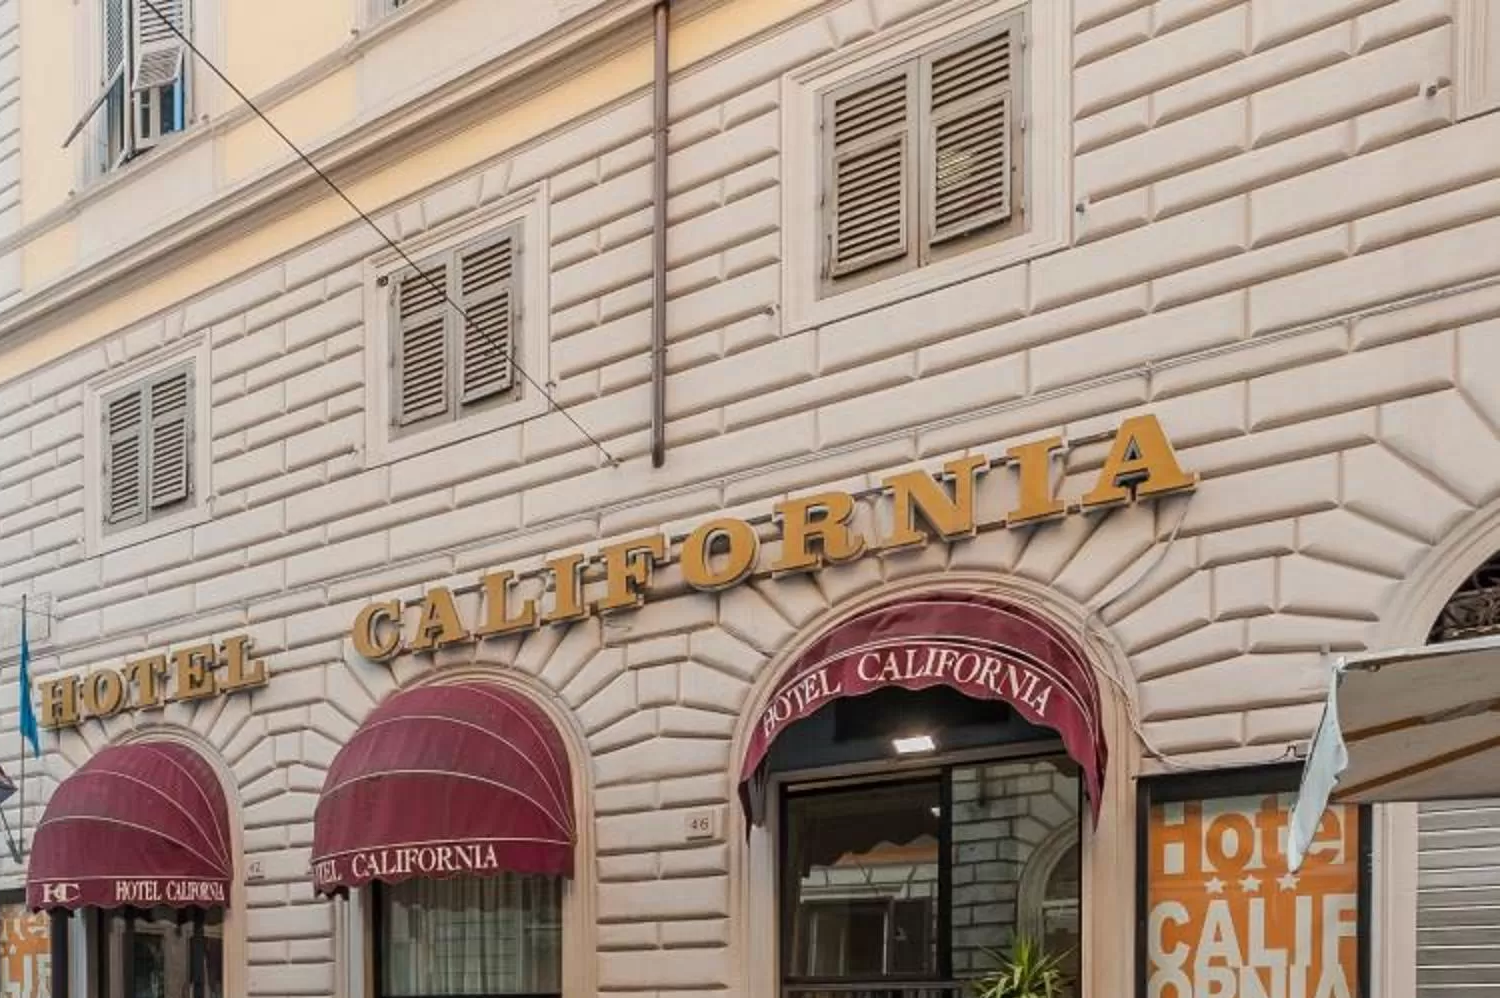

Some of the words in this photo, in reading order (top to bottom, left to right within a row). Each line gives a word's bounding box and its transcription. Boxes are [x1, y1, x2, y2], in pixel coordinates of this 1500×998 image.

[38, 635, 267, 728] HOTEL
[352, 414, 1197, 660] CALIFORNIA
[762, 669, 842, 738] HOTEL
[857, 647, 1052, 717] CALIFORNIA
[115, 880, 161, 901] HOTEL
[165, 881, 224, 901] CALIFORNIA
[351, 843, 498, 878] CALIFORNIA
[1148, 893, 1357, 968] CALIF
